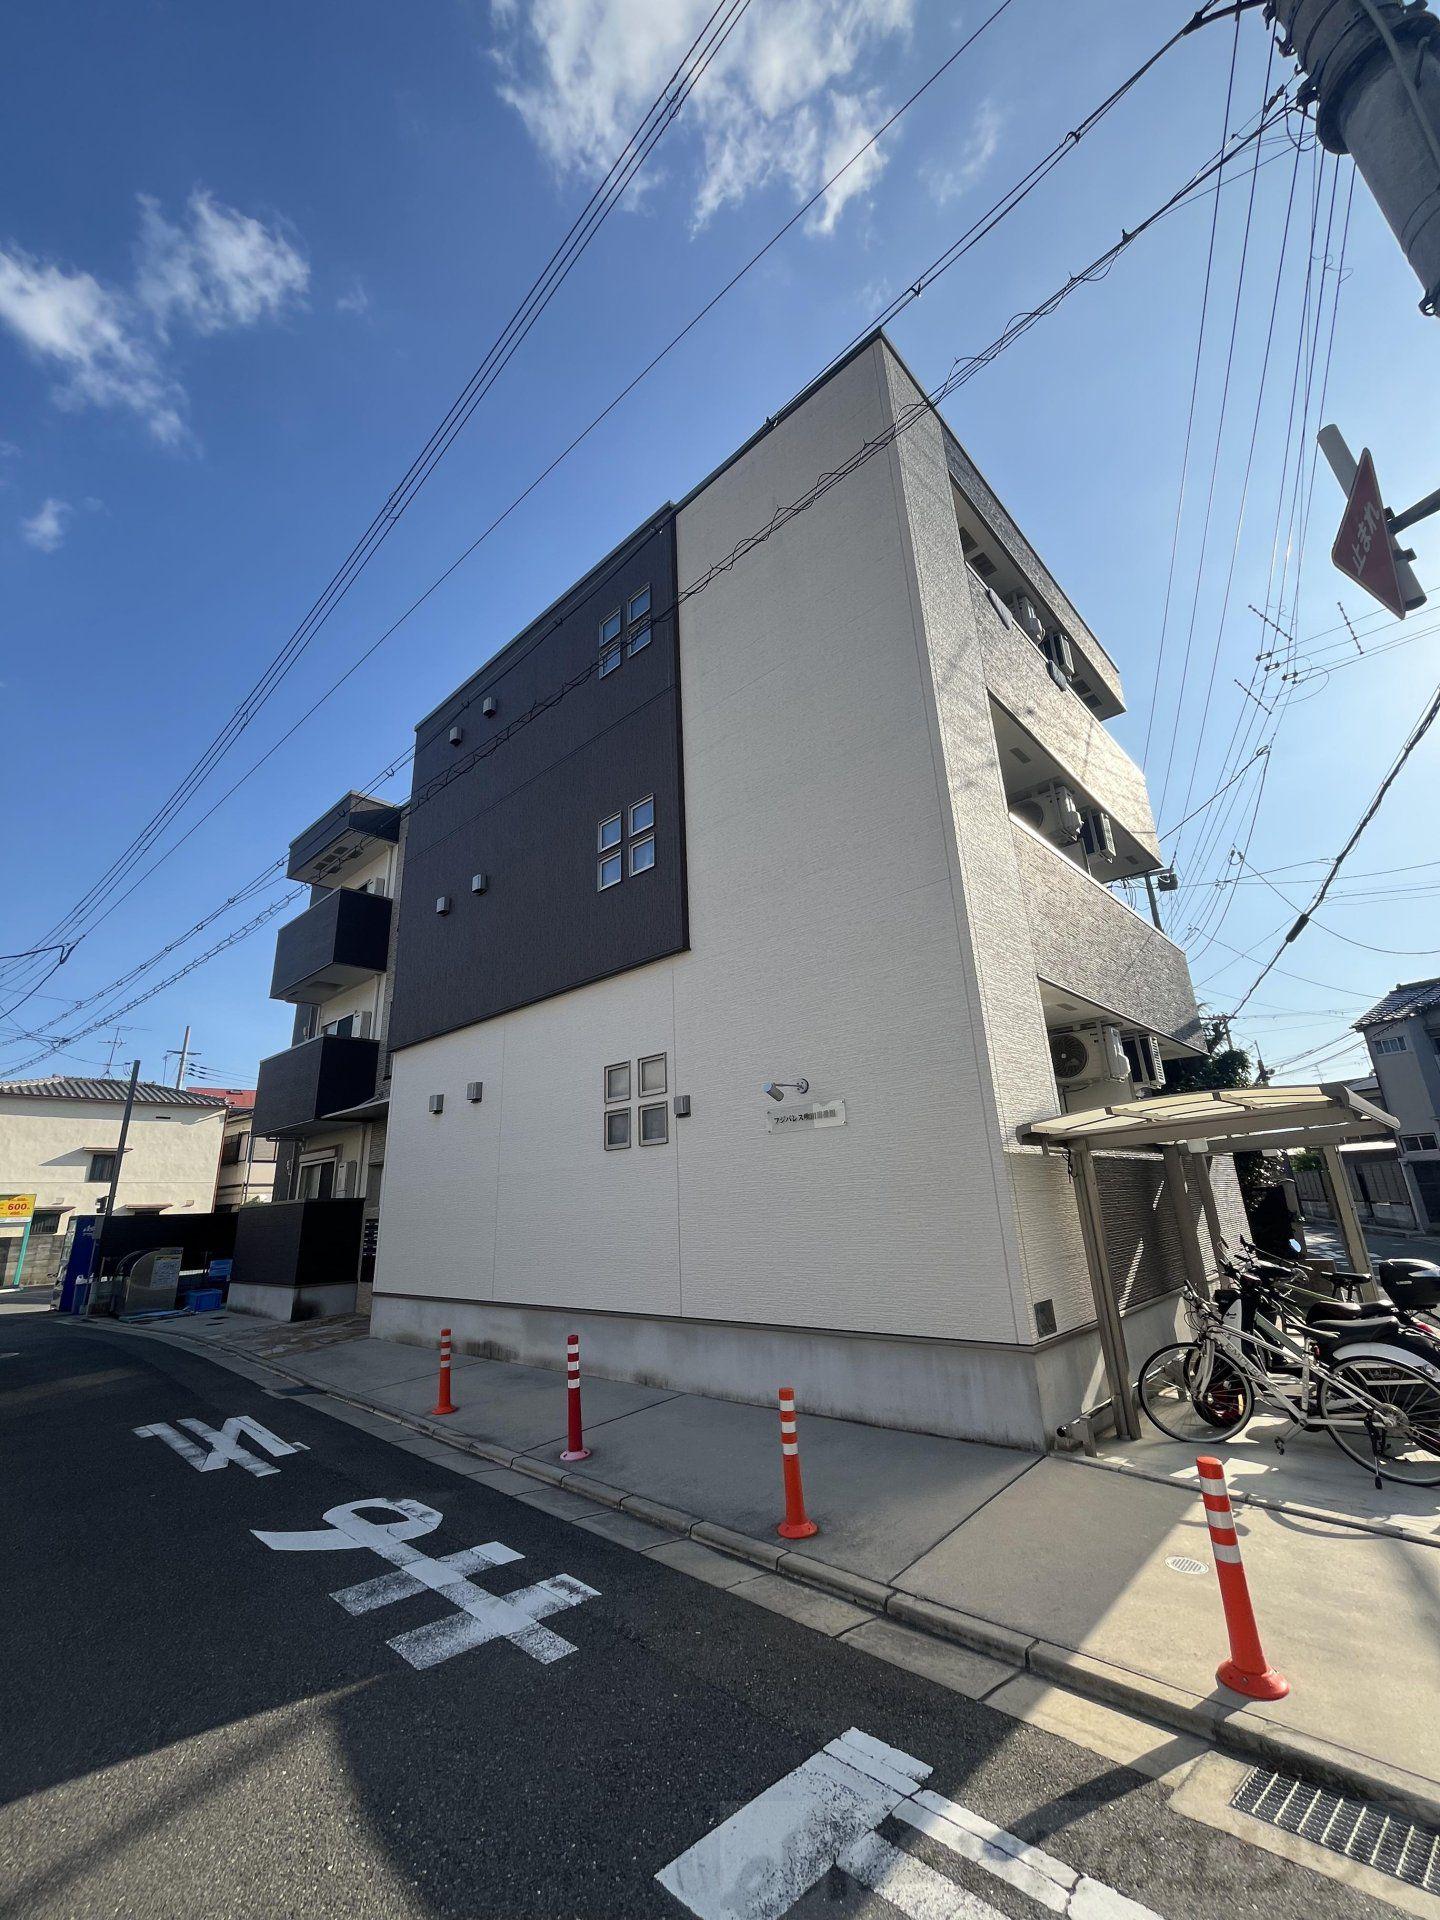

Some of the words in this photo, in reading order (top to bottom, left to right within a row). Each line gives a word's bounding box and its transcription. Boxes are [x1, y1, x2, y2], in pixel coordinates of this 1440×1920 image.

[1351, 501, 1381, 577] 止まれ
[7, 1203, 27, 1211] 600
